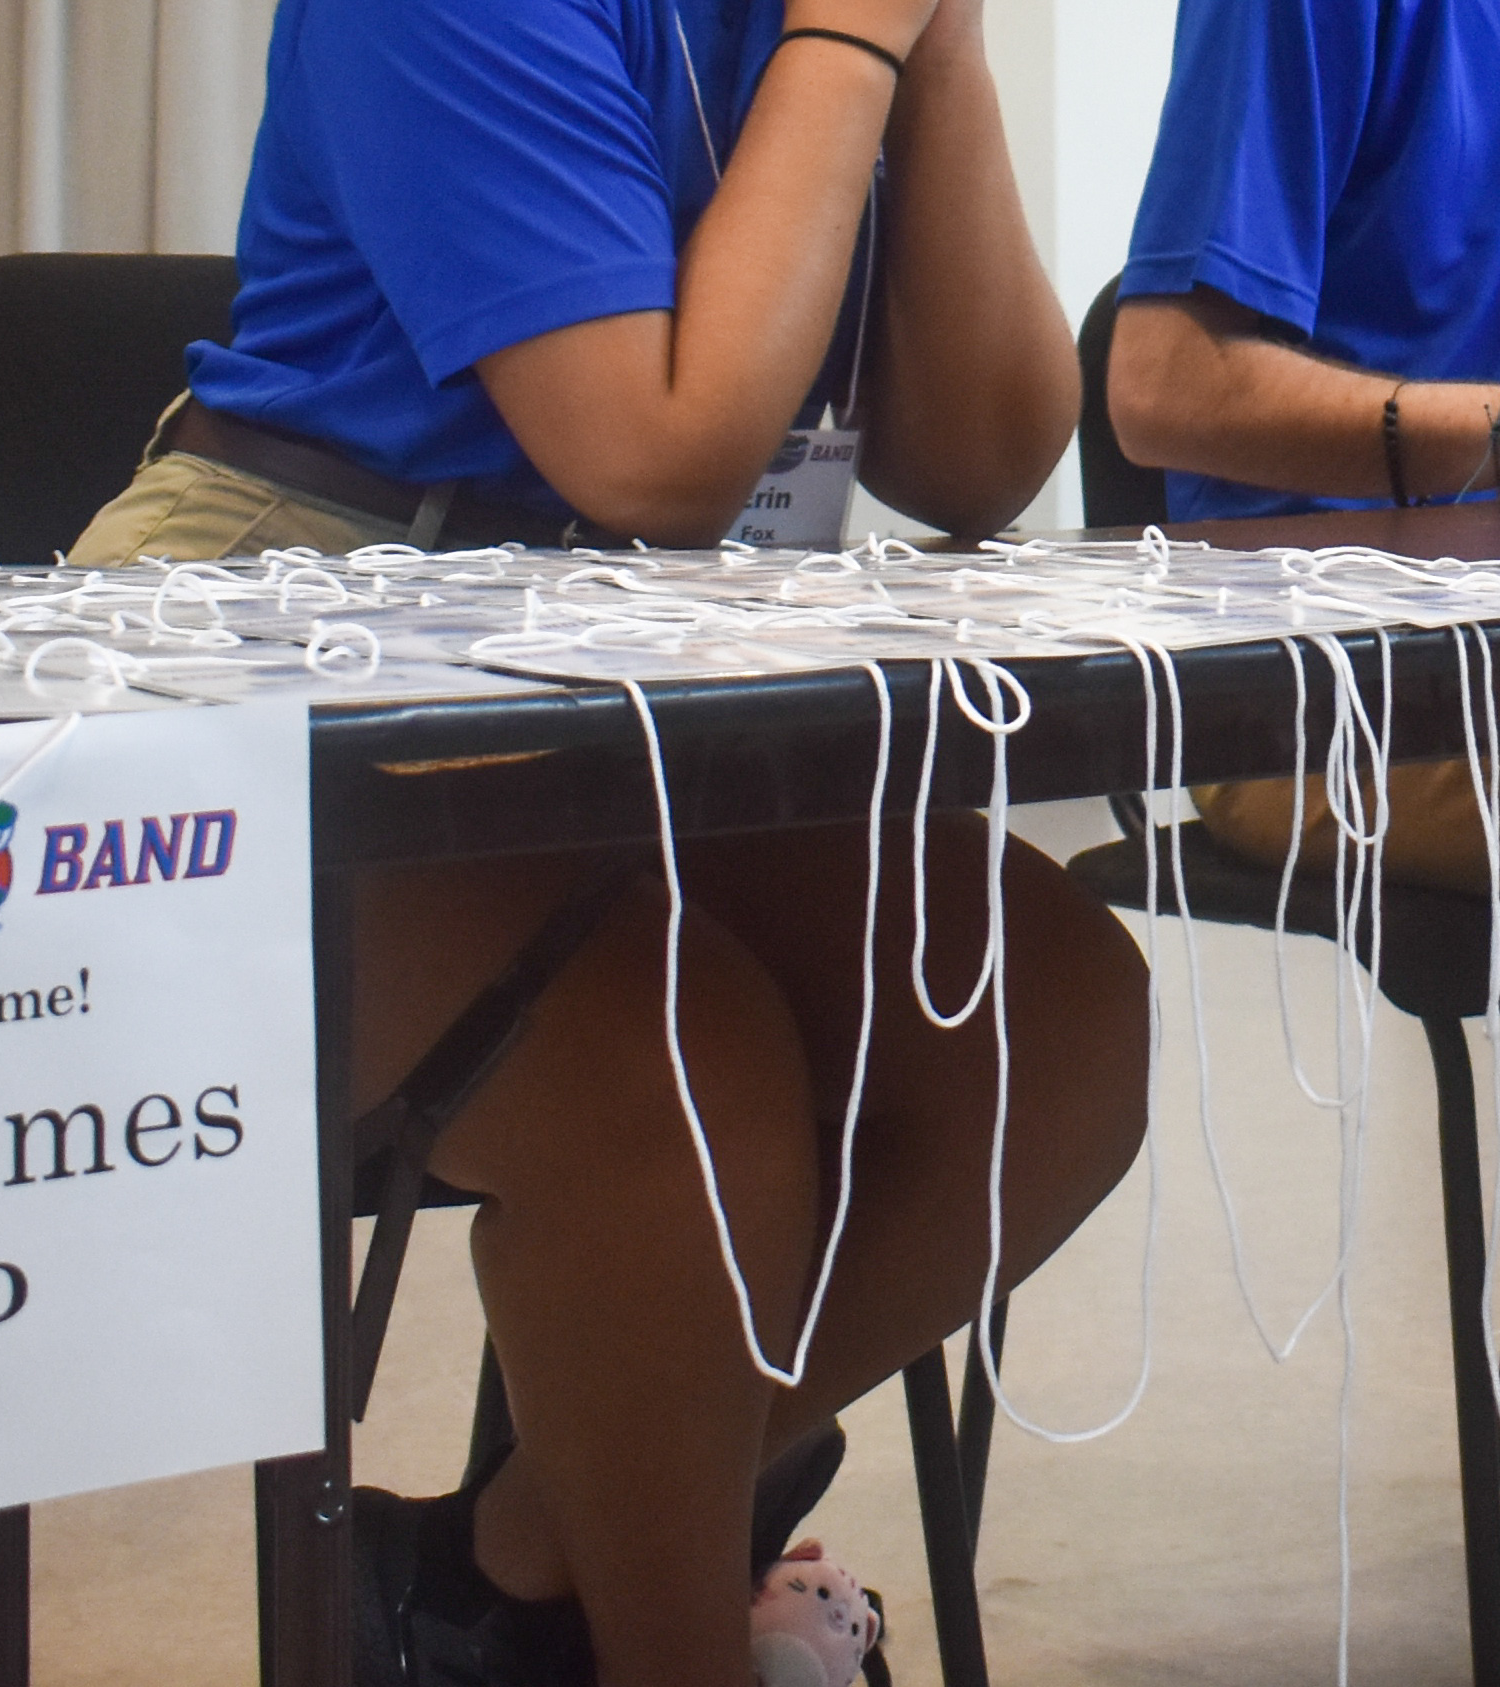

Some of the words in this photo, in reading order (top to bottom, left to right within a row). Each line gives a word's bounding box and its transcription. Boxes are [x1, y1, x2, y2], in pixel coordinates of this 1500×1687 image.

[809, 444, 855, 463] BAND
[740, 524, 775, 542] Fox
[34, 808, 238, 896] BAND
